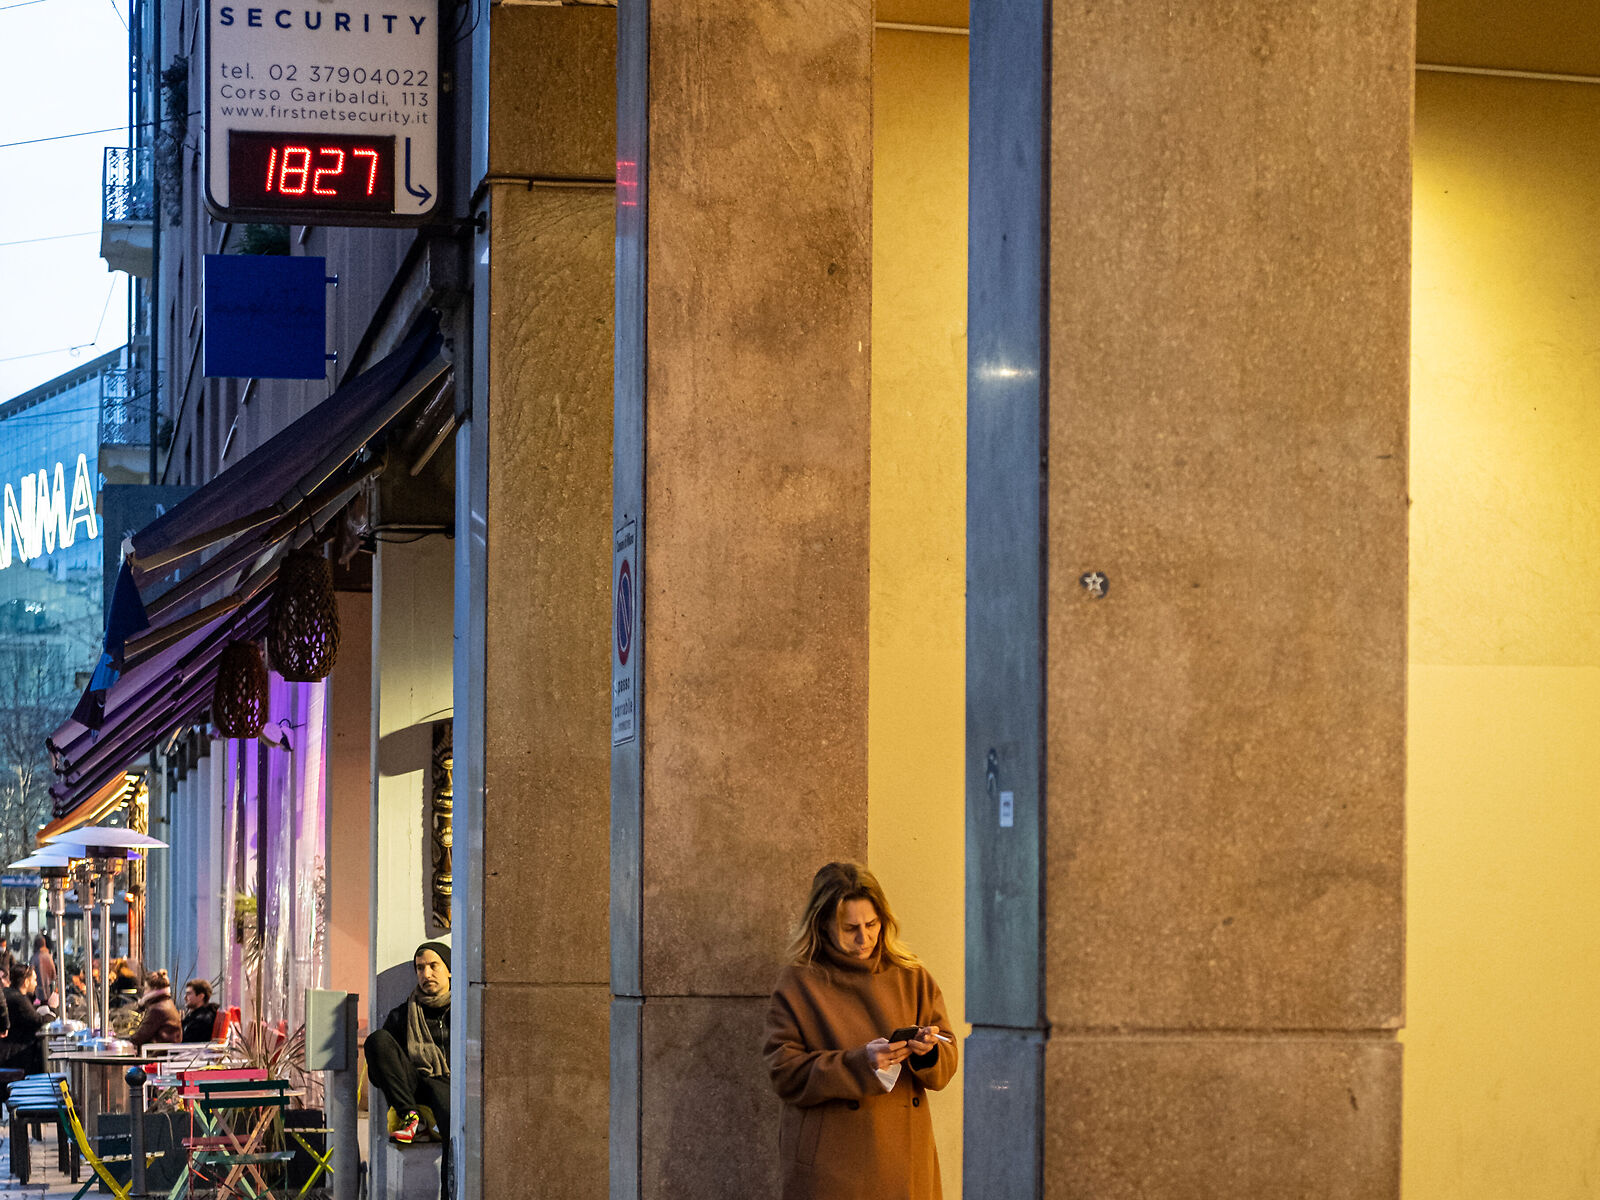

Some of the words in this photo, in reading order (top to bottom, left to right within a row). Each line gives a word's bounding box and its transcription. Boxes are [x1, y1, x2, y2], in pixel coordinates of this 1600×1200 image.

[219, 6, 427, 35] SECURITY
[221, 62, 255, 80] tel.
[269, 63, 298, 82] 02
[309, 65, 429, 87] 37904022
[220, 84, 281, 101] Corso
[290, 87, 389, 107] Garibaldi,
[401, 92, 429, 107] 113
[221, 105, 429, 126] www.firstnetsecurity.it
[265, 146, 380, 196] 1827
